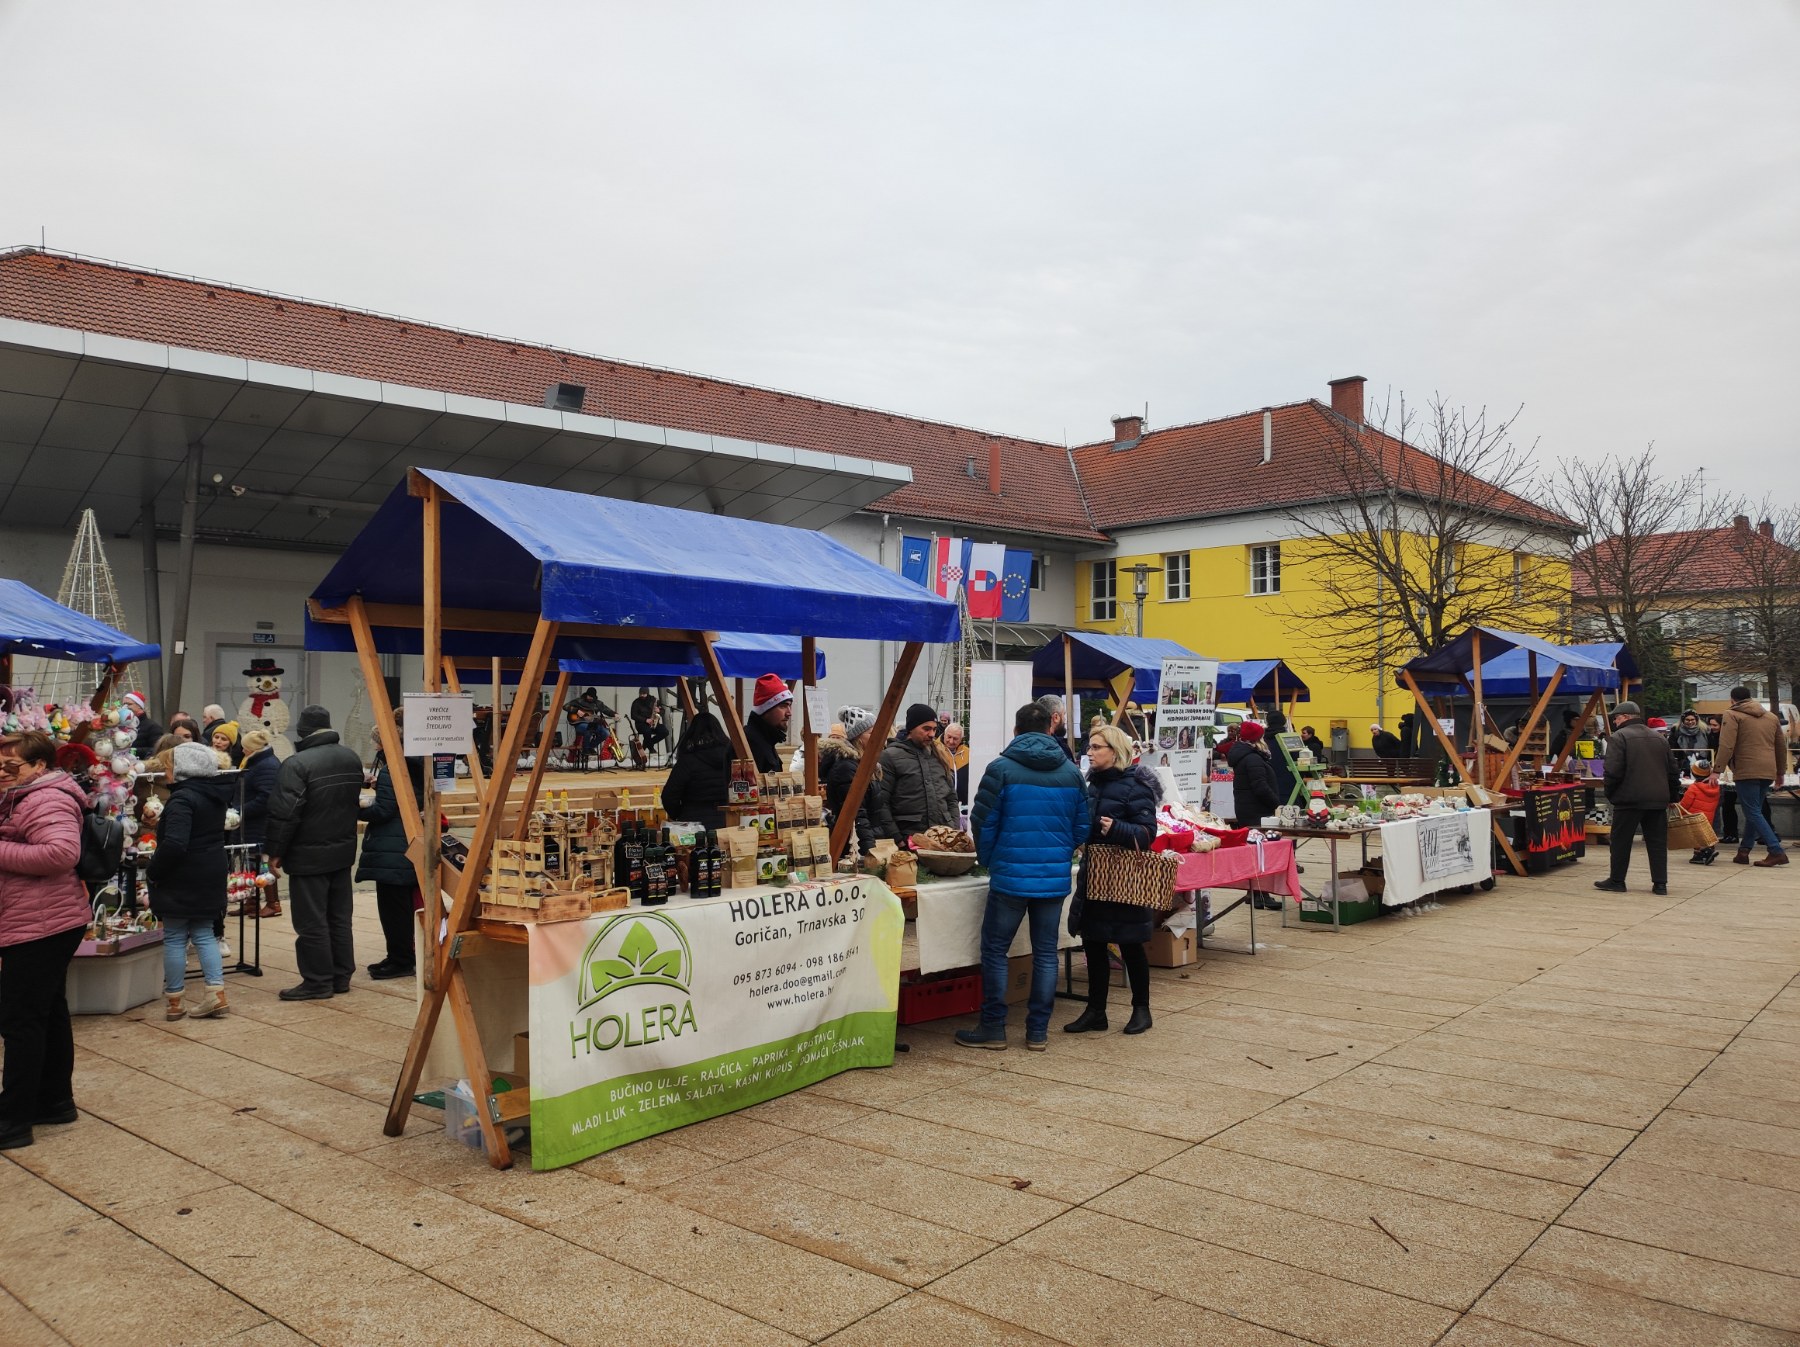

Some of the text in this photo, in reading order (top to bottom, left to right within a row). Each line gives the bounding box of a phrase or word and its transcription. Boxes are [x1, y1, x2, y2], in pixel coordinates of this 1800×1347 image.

[729, 885, 867, 922] HOLERA d.o.o.
[735, 907, 866, 946] Goričan, Trnavska 30
[733, 972, 752, 986] 095
[755, 968, 772, 981] 873
[775, 962, 797, 976] 6094
[806, 956, 824, 969] 098
[827, 951, 844, 964] 186
[749, 966, 847, 998] holera.doo@gmail.com
[569, 999, 698, 1059] HOLERA
[610, 1081, 653, 1102] BUČINO
[657, 1075, 689, 1090] ULJE
[700, 1061, 743, 1082] RAJČICA
[752, 1049, 789, 1067] PAPRIKA
[572, 1113, 602, 1136] MLADI
[605, 1105, 627, 1123] LUK
[638, 1092, 681, 1113] ZELENA
[685, 1083, 725, 1101] SALATA
[735, 1072, 762, 1090] KASNI
[765, 1061, 793, 1079] KUPUS
